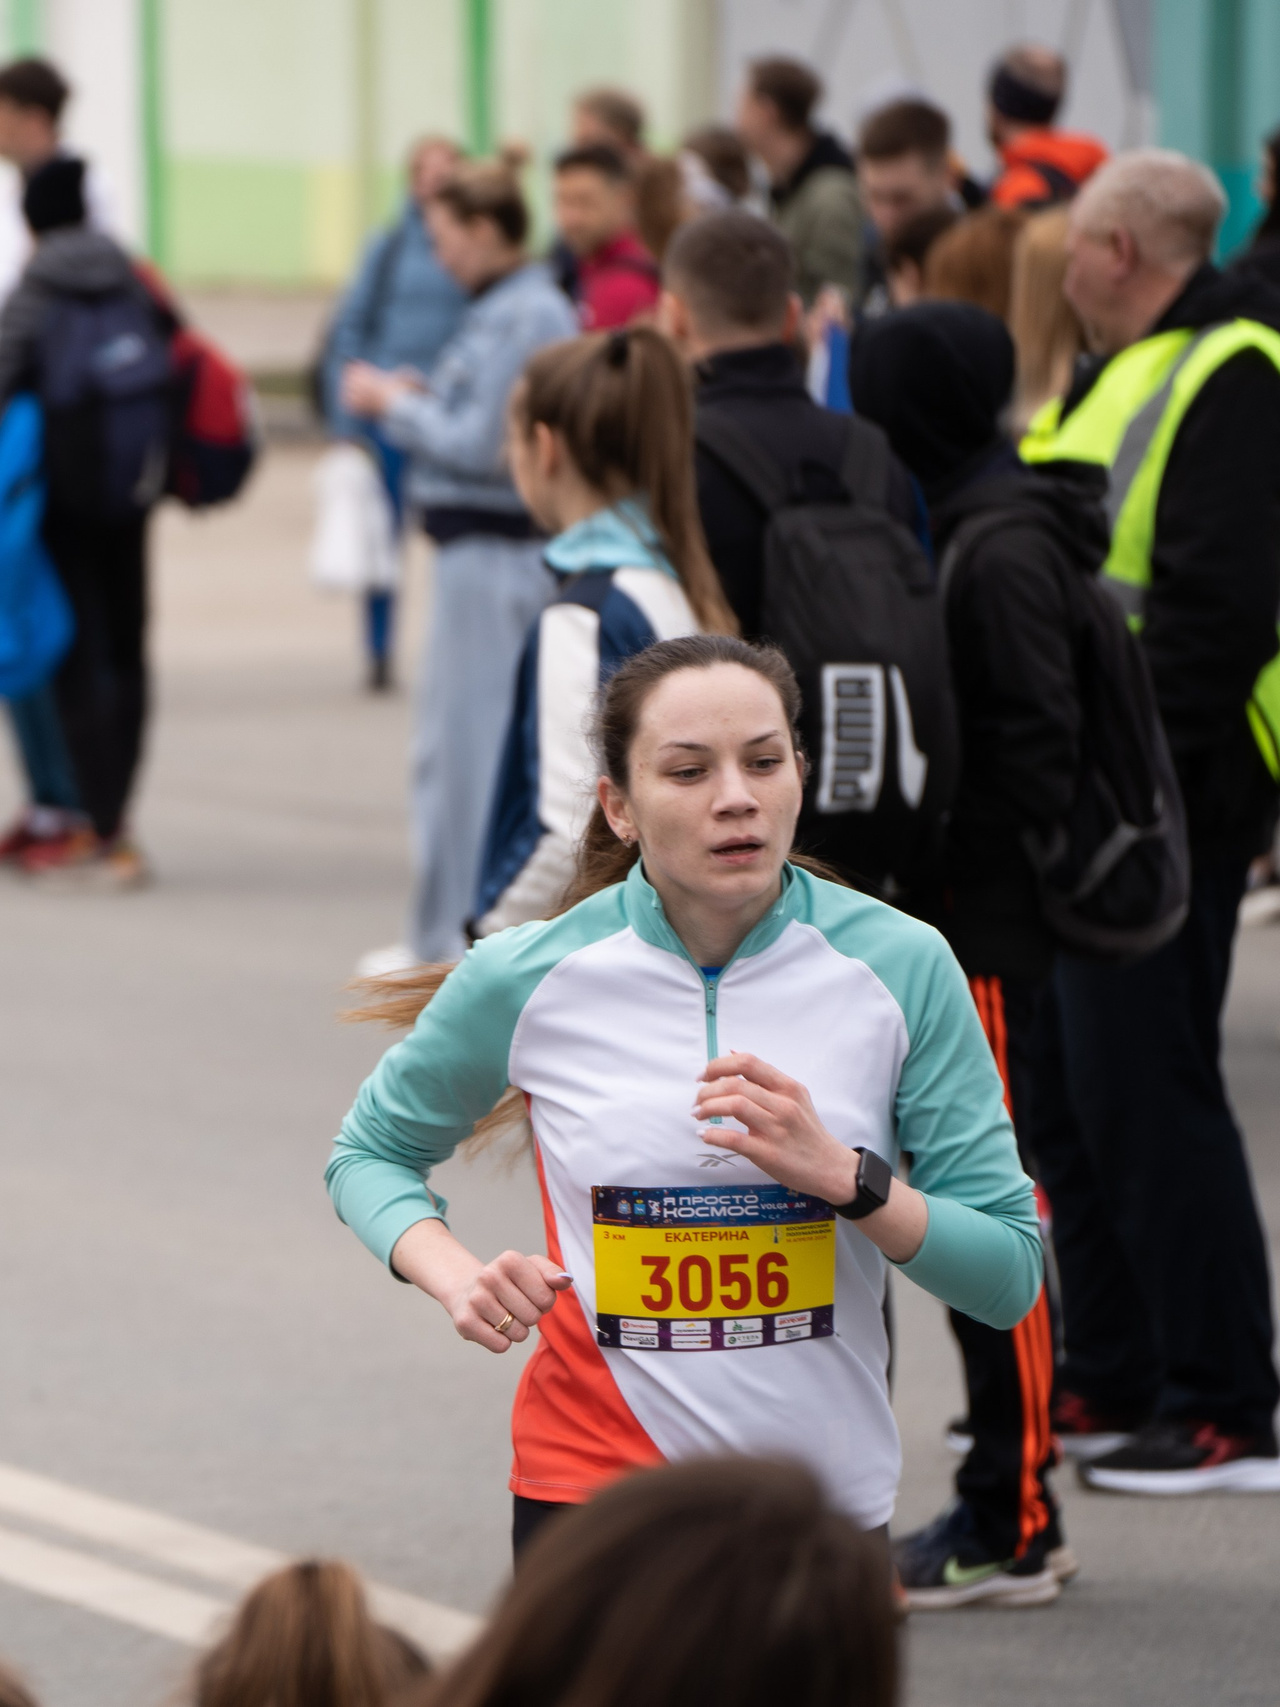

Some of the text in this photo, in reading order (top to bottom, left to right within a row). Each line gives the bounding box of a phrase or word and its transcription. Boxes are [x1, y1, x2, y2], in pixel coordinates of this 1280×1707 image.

[818, 664, 886, 813] PUMA
[663, 1195, 759, 1206] Я ПРОСТО
[663, 1205, 760, 1218] КОСМОС
[603, 1231, 610, 1239] 3
[665, 1230, 750, 1242] ЕКАТЕРИНА
[640, 1251, 789, 1312] 3056
